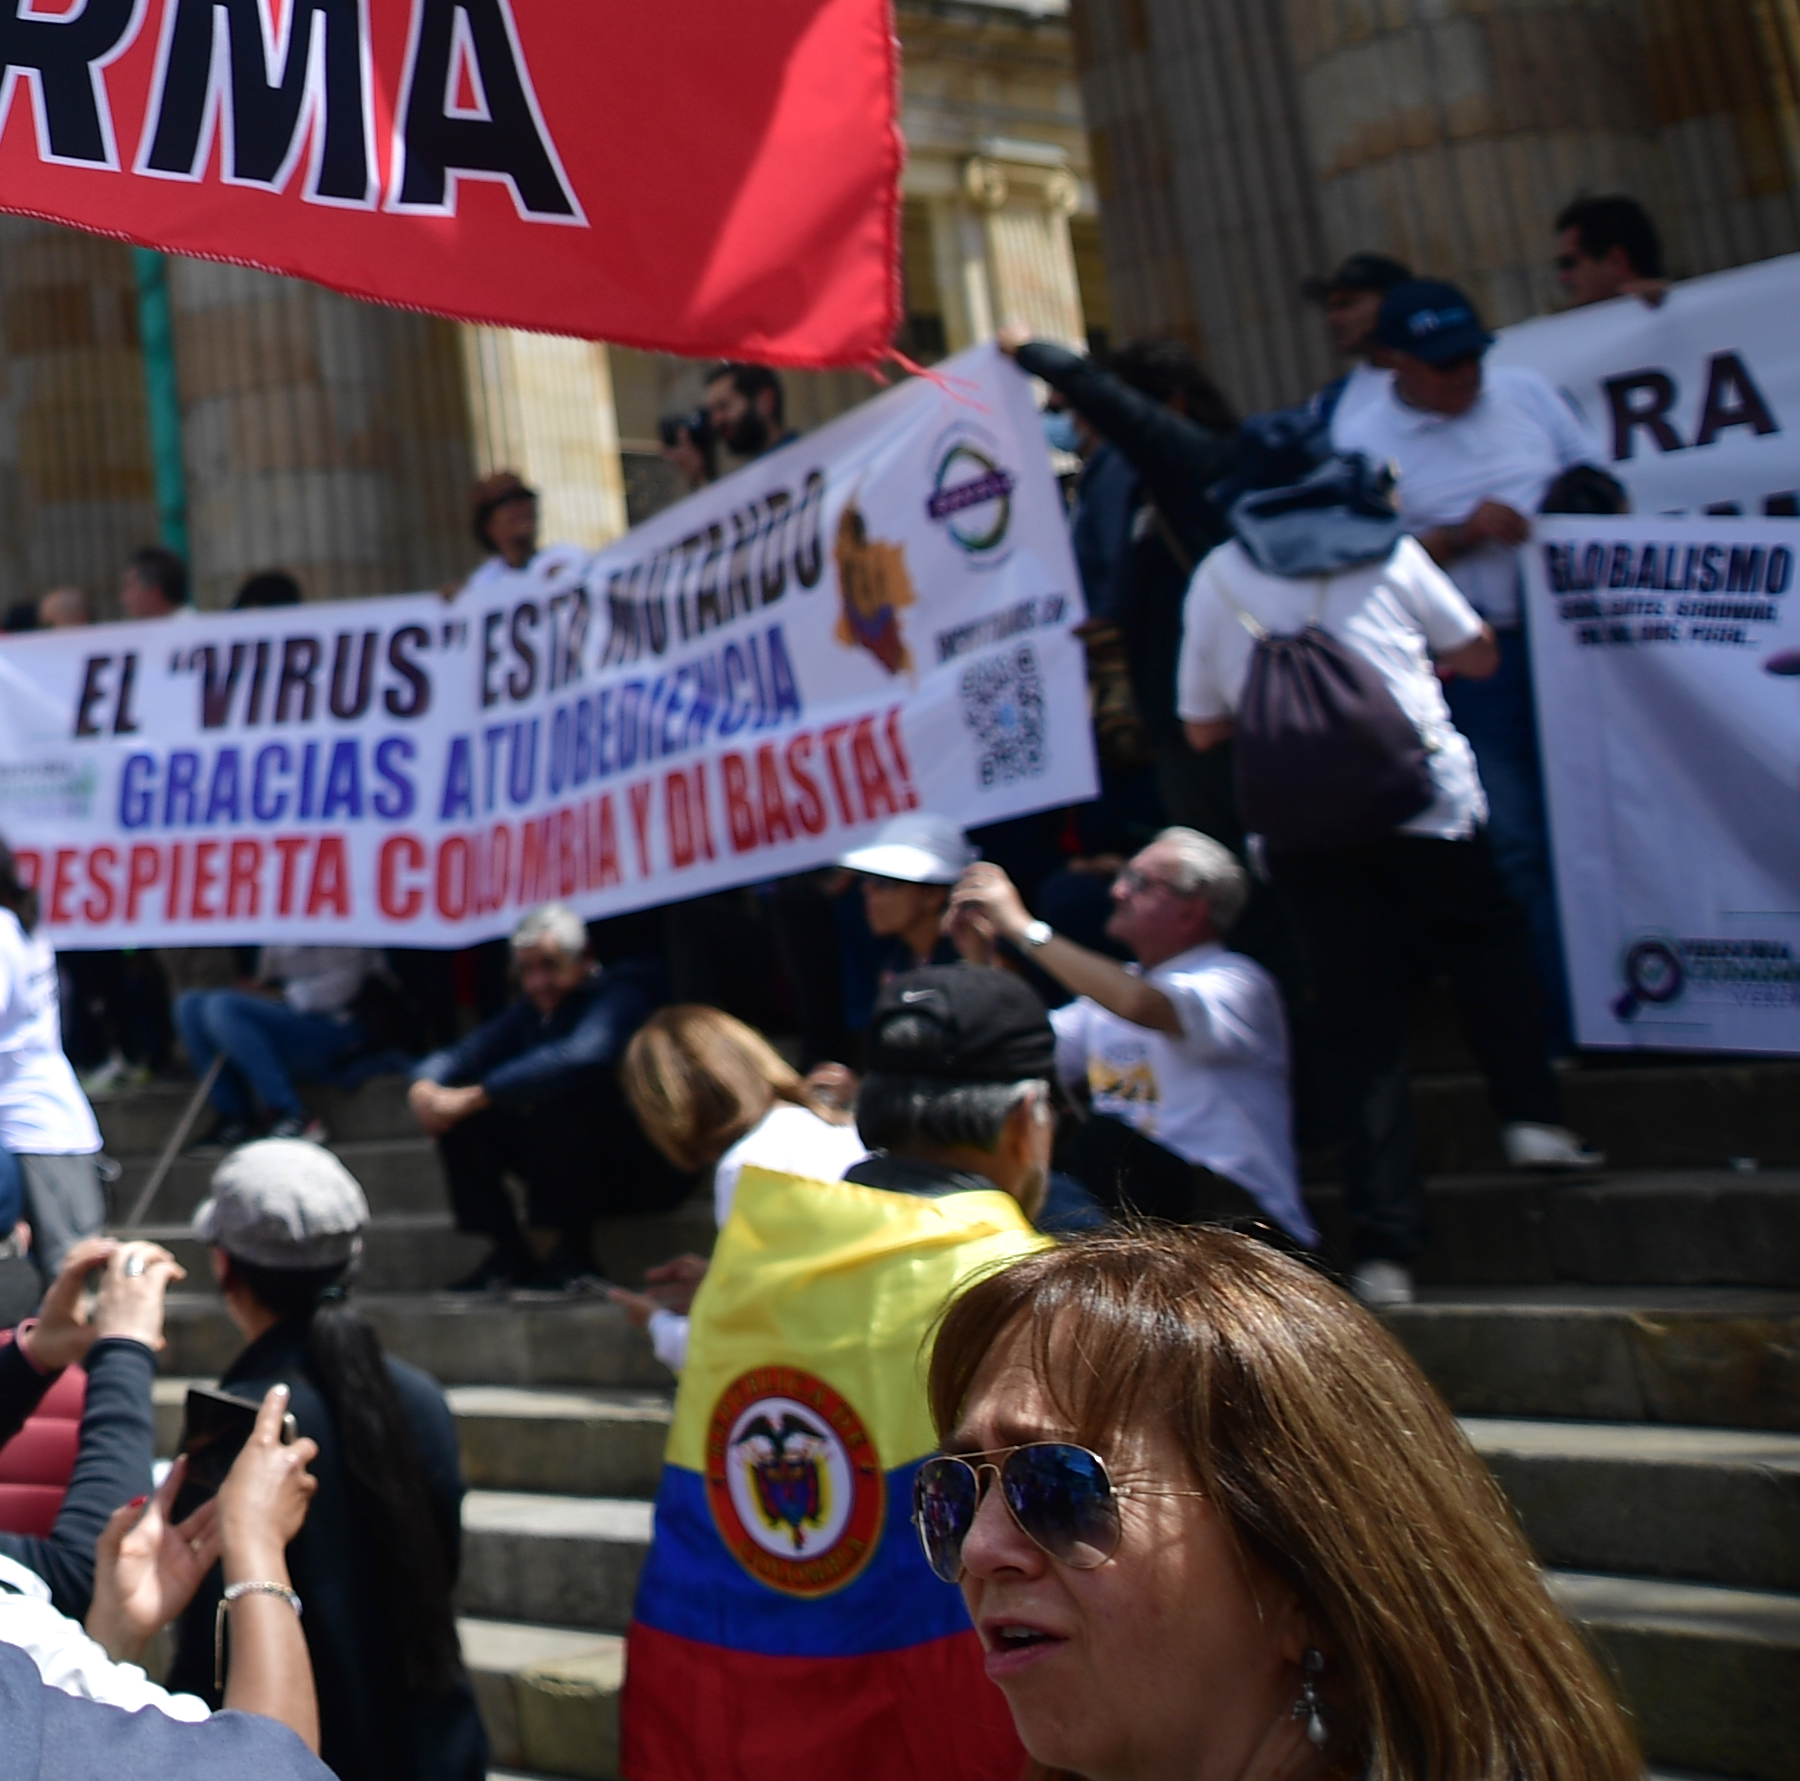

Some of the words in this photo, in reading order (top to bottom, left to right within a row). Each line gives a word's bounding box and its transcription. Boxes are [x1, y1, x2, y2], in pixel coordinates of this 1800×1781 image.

[1560, 349, 1782, 460] RA
[73, 649, 141, 737] EL
[168, 615, 468, 727] "VIRUS"
[602, 469, 826, 667] MUTANDO
[118, 735, 418, 830] GRACIAS
[440, 733, 474, 820] A
[483, 719, 538, 809] TU
[546, 623, 802, 795] OBEDIENCIA
[376, 795, 622, 925] COLOMBIA
[628, 779, 653, 880] Y
[665, 765, 716, 870] DI
[720, 705, 923, 855] BASTA!
